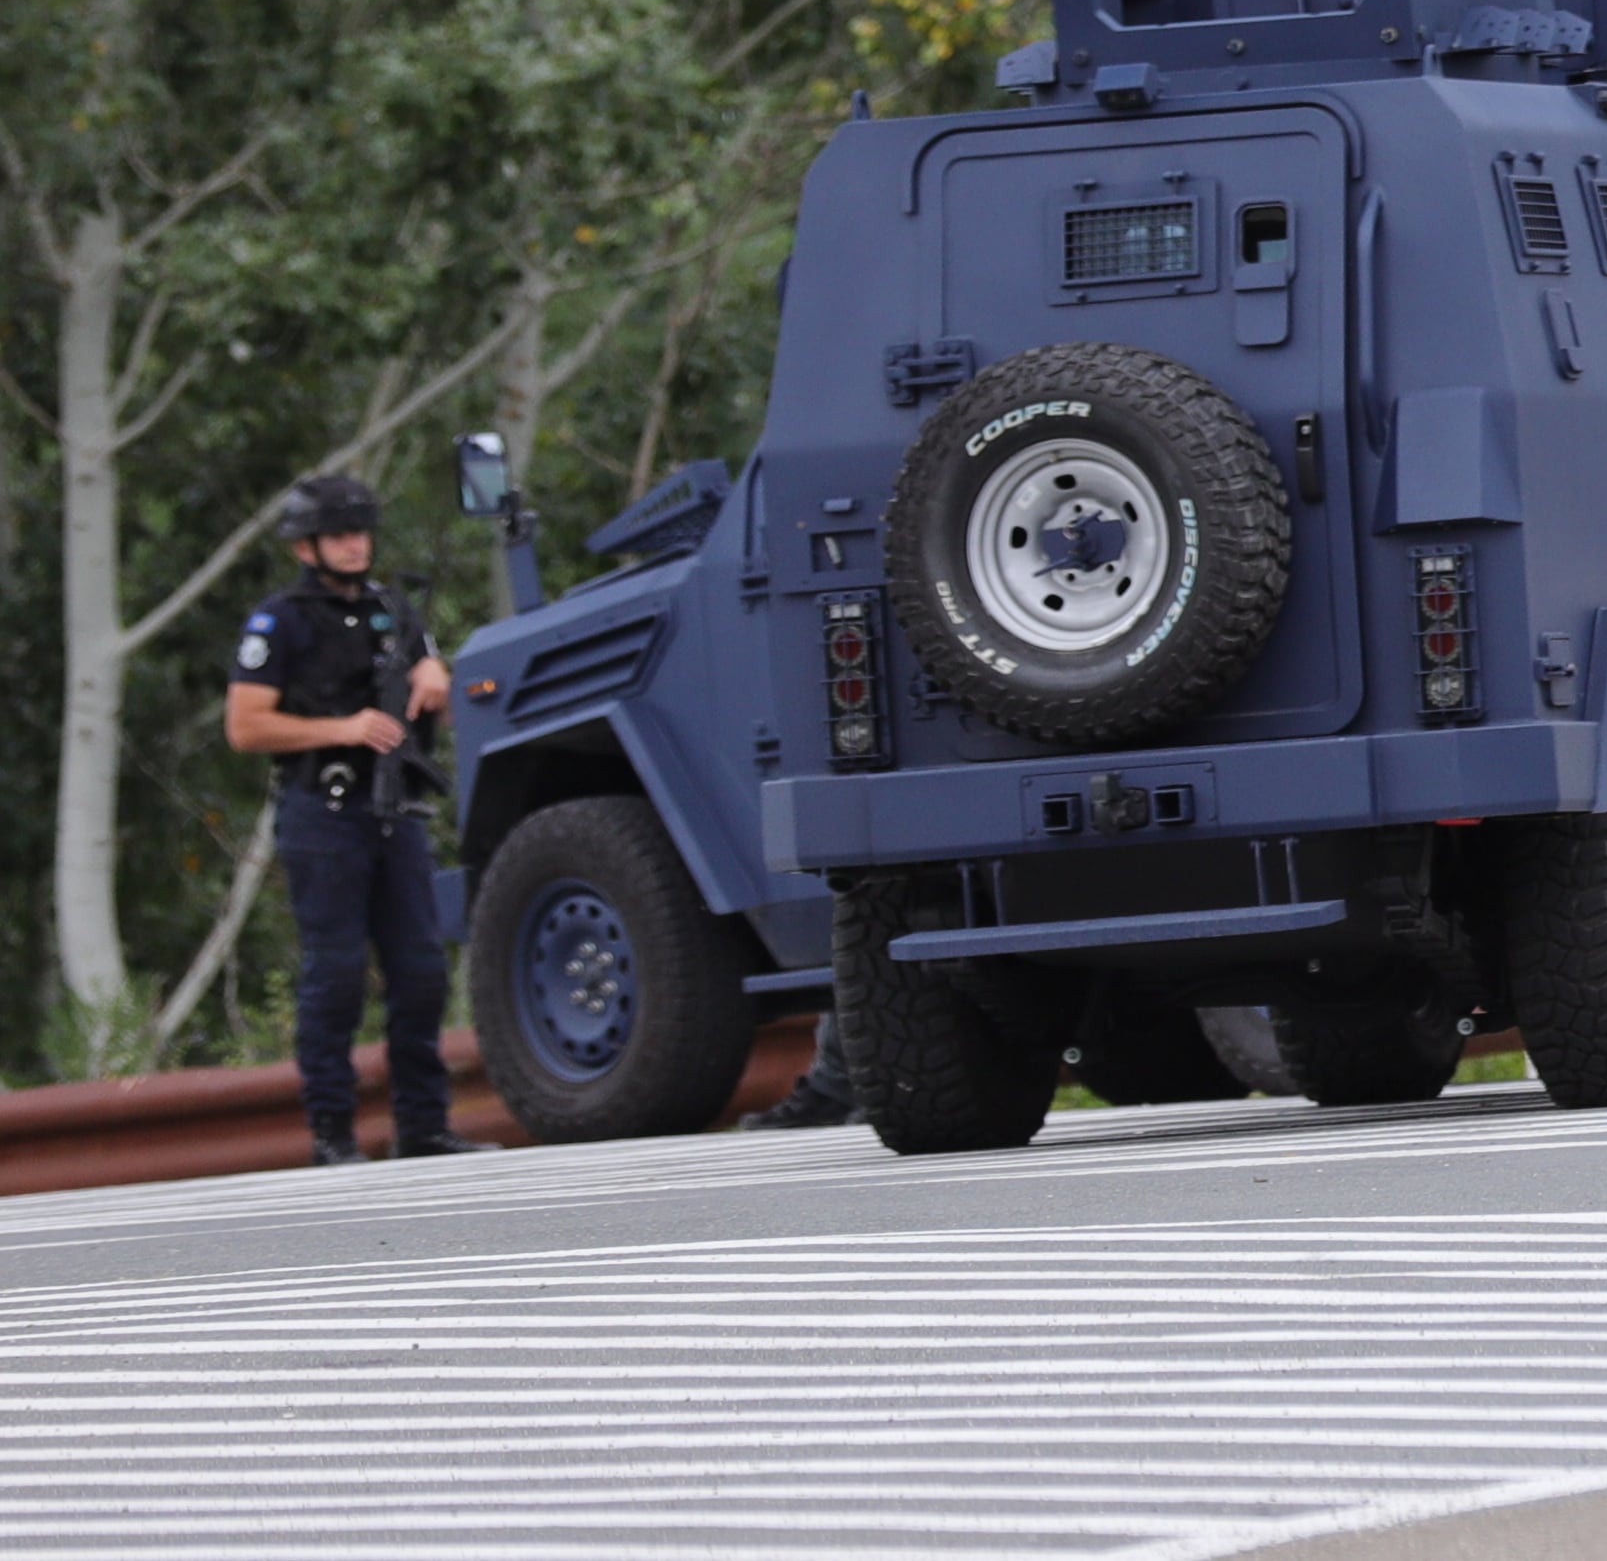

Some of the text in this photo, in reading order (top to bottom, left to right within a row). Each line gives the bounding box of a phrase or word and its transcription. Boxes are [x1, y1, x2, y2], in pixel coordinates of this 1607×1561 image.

[965, 400, 1093, 458] COOPER
[935, 580, 1019, 675] STT PRO
[1125, 498, 1200, 667] DISCOVERER
